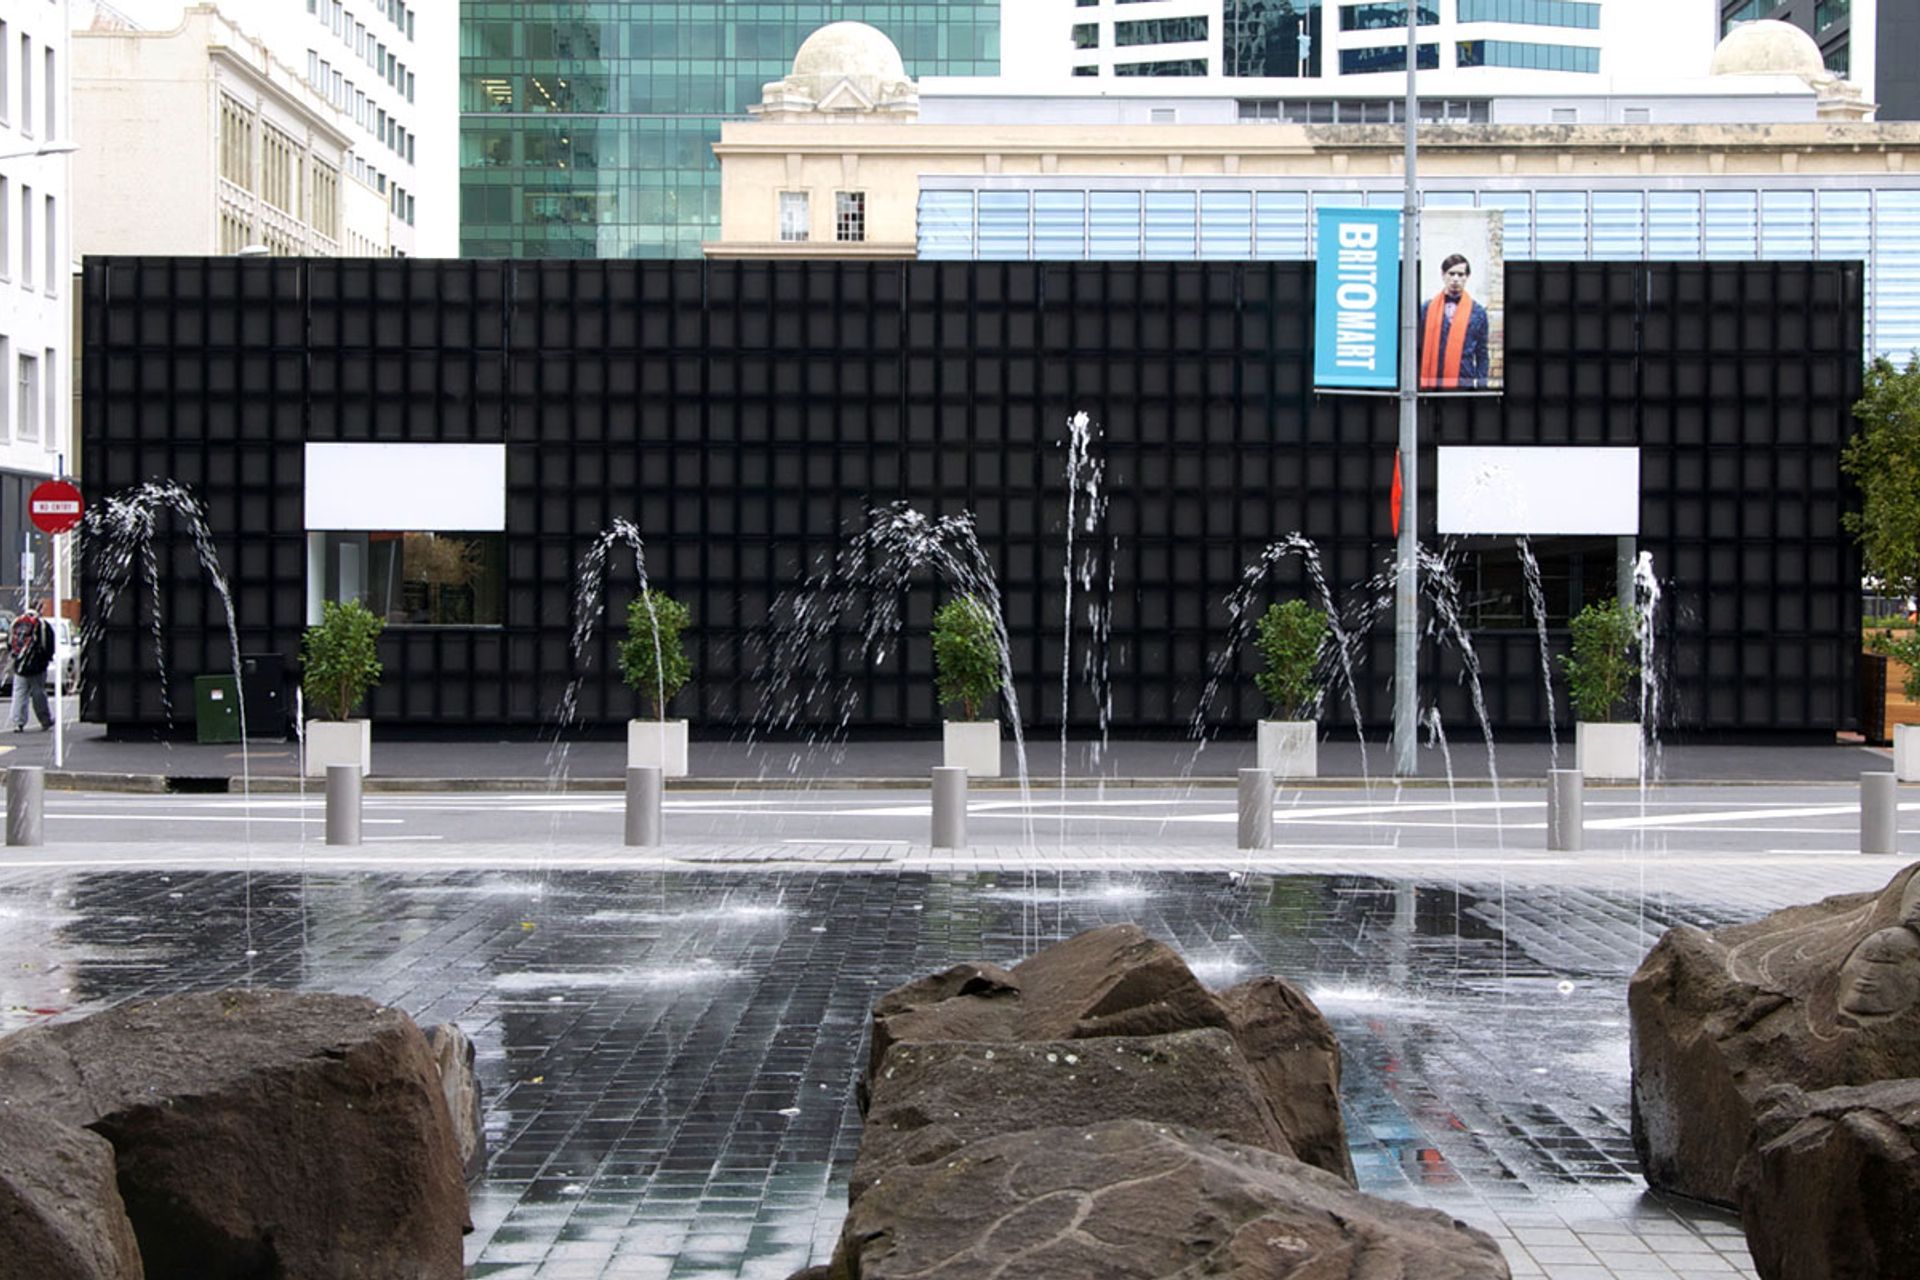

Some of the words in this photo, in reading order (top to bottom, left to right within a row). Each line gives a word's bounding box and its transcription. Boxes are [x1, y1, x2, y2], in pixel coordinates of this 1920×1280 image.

[1335, 223, 1378, 371] BRITOMART
[40, 503, 49, 511] NO
[51, 503, 71, 511] ENTRY
